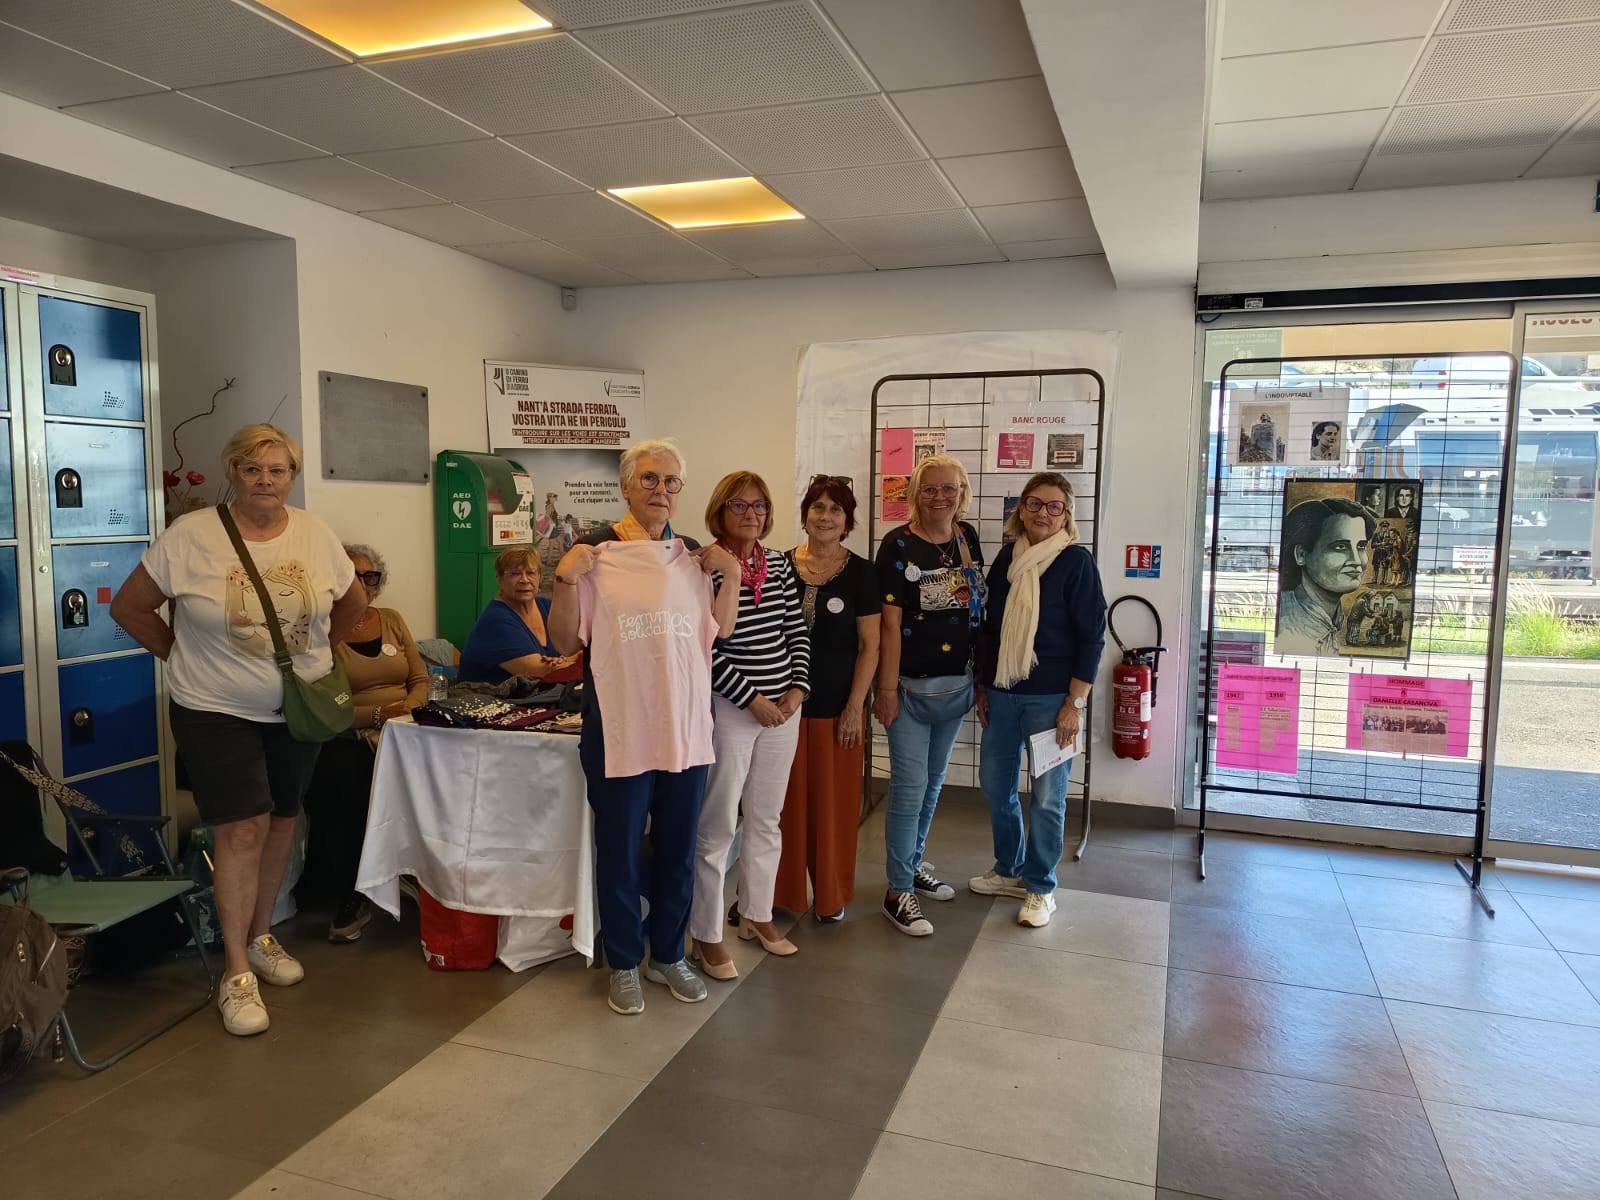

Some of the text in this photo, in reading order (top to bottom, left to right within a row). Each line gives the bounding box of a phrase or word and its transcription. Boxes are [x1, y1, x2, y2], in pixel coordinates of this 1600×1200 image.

[518, 400, 620, 416] NANT'A STRADA FERRATA,
[512, 414, 626, 428] VOSTRA VITA HE IN PERICULU
[1012, 416, 1034, 424] BANC
[1389, 679, 1424, 687] HOMMAGE
